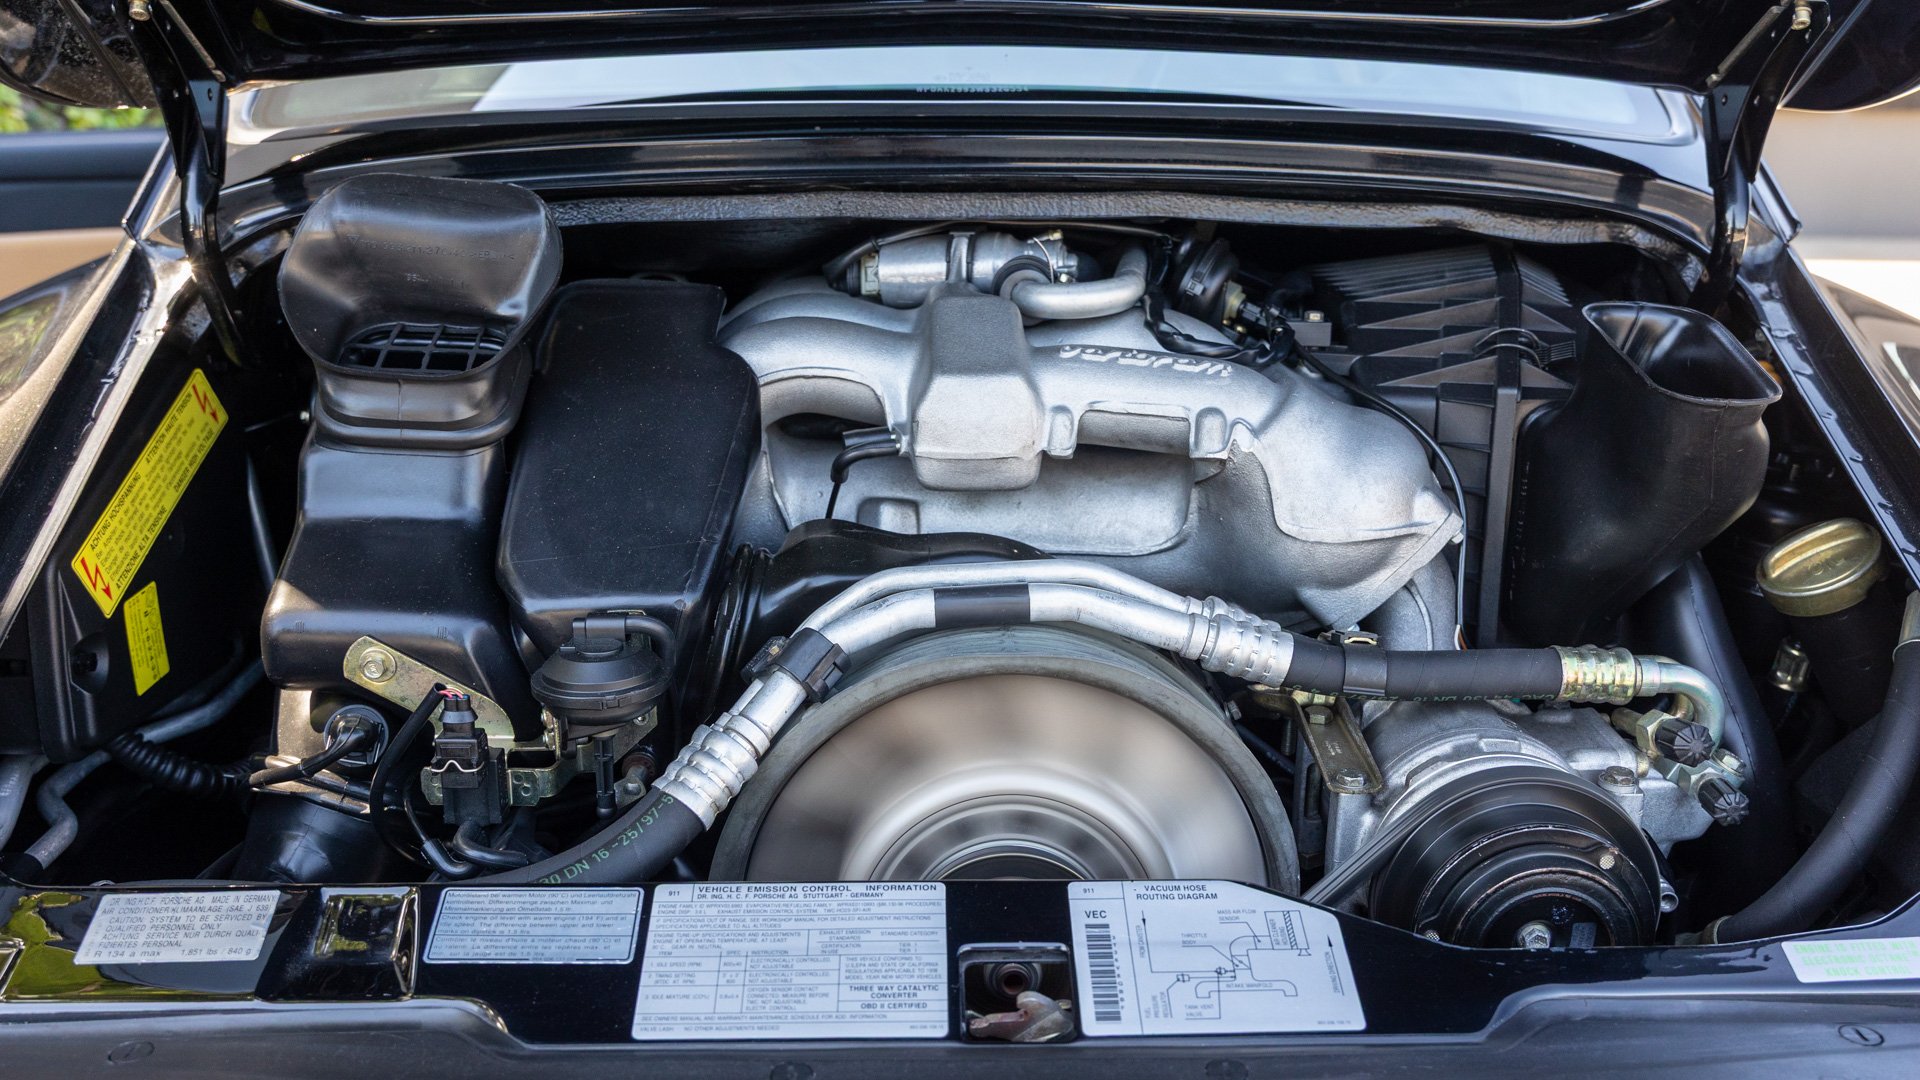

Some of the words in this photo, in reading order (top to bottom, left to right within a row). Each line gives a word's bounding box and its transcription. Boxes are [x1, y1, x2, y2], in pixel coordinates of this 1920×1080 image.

[563, 859, 590, 880] DN
[592, 848, 610, 864] 16
[159, 897, 192, 905] PORSCHE
[211, 896, 231, 904] MADE
[243, 895, 275, 903] GERMANY
[106, 924, 146, 932] QUALIFIED
[184, 931, 201, 939] NUR
[142, 940, 182, 948] PERSONAL
